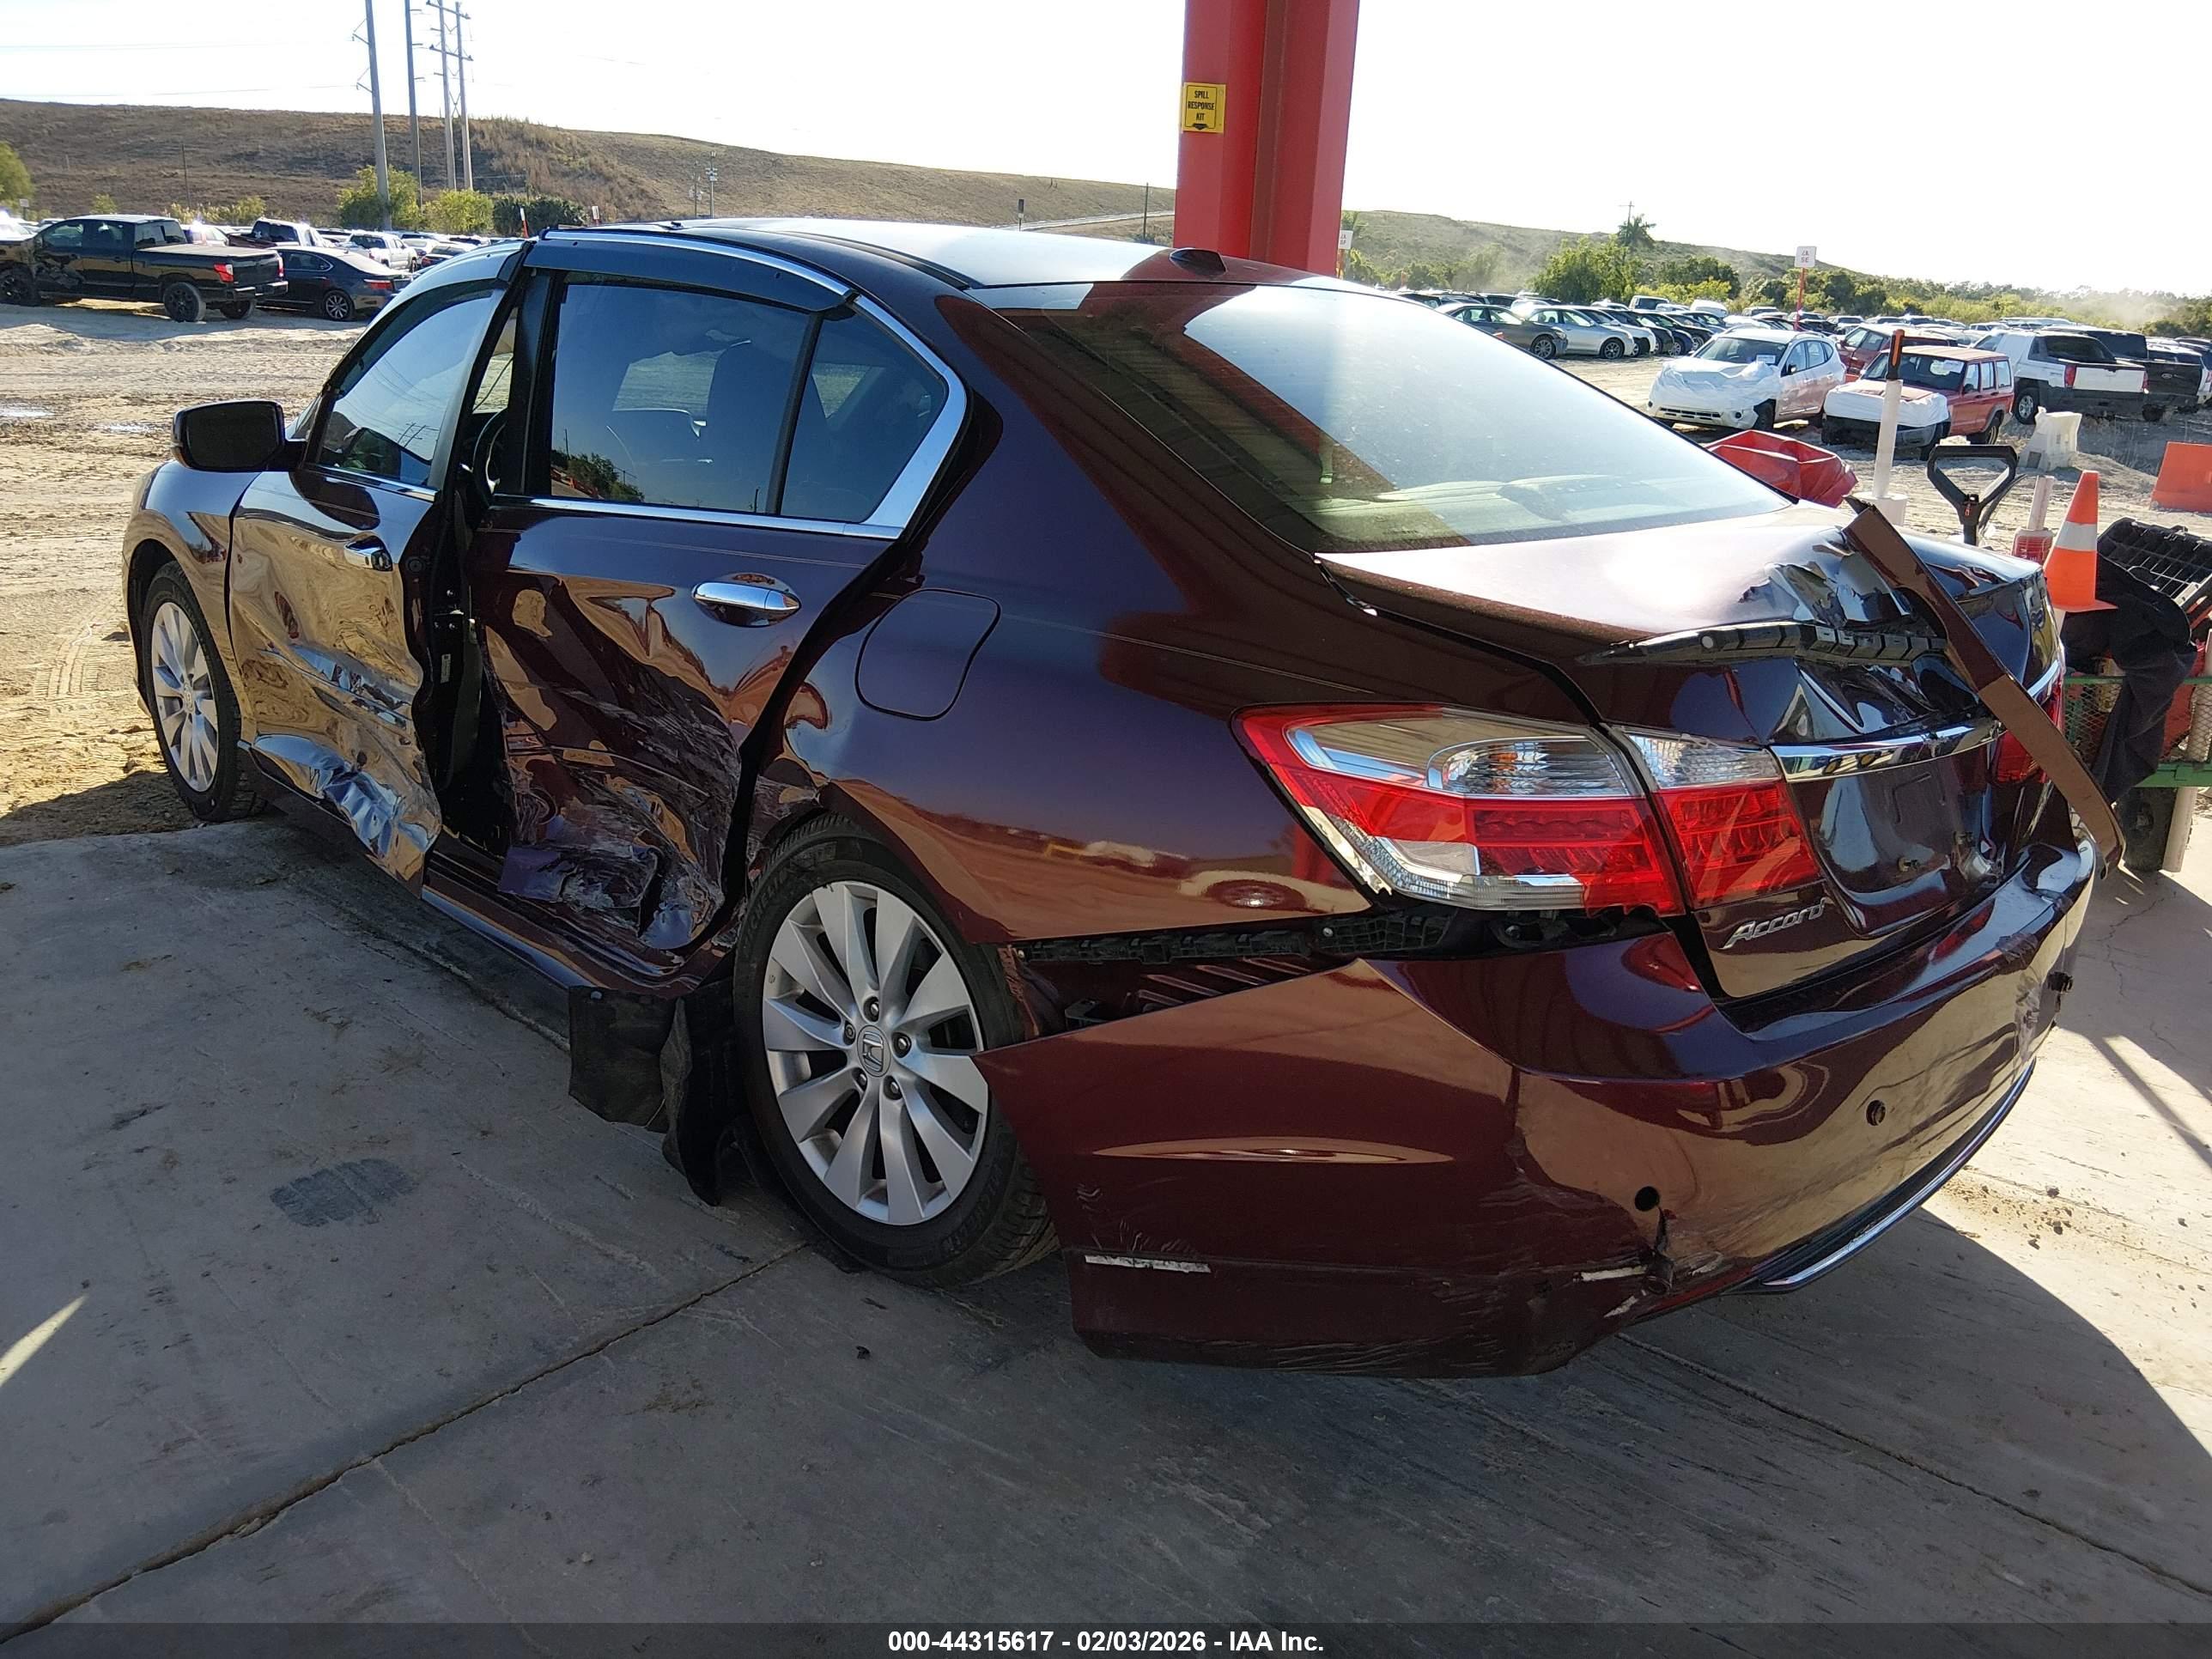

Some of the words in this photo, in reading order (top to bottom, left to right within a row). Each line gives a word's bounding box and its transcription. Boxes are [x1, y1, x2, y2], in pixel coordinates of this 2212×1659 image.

[1194, 90, 1209, 99] SPILL
[1188, 101, 1215, 110] RESPONSE
[1195, 112, 1206, 121] KIT
[1718, 896, 1827, 950] Accord
